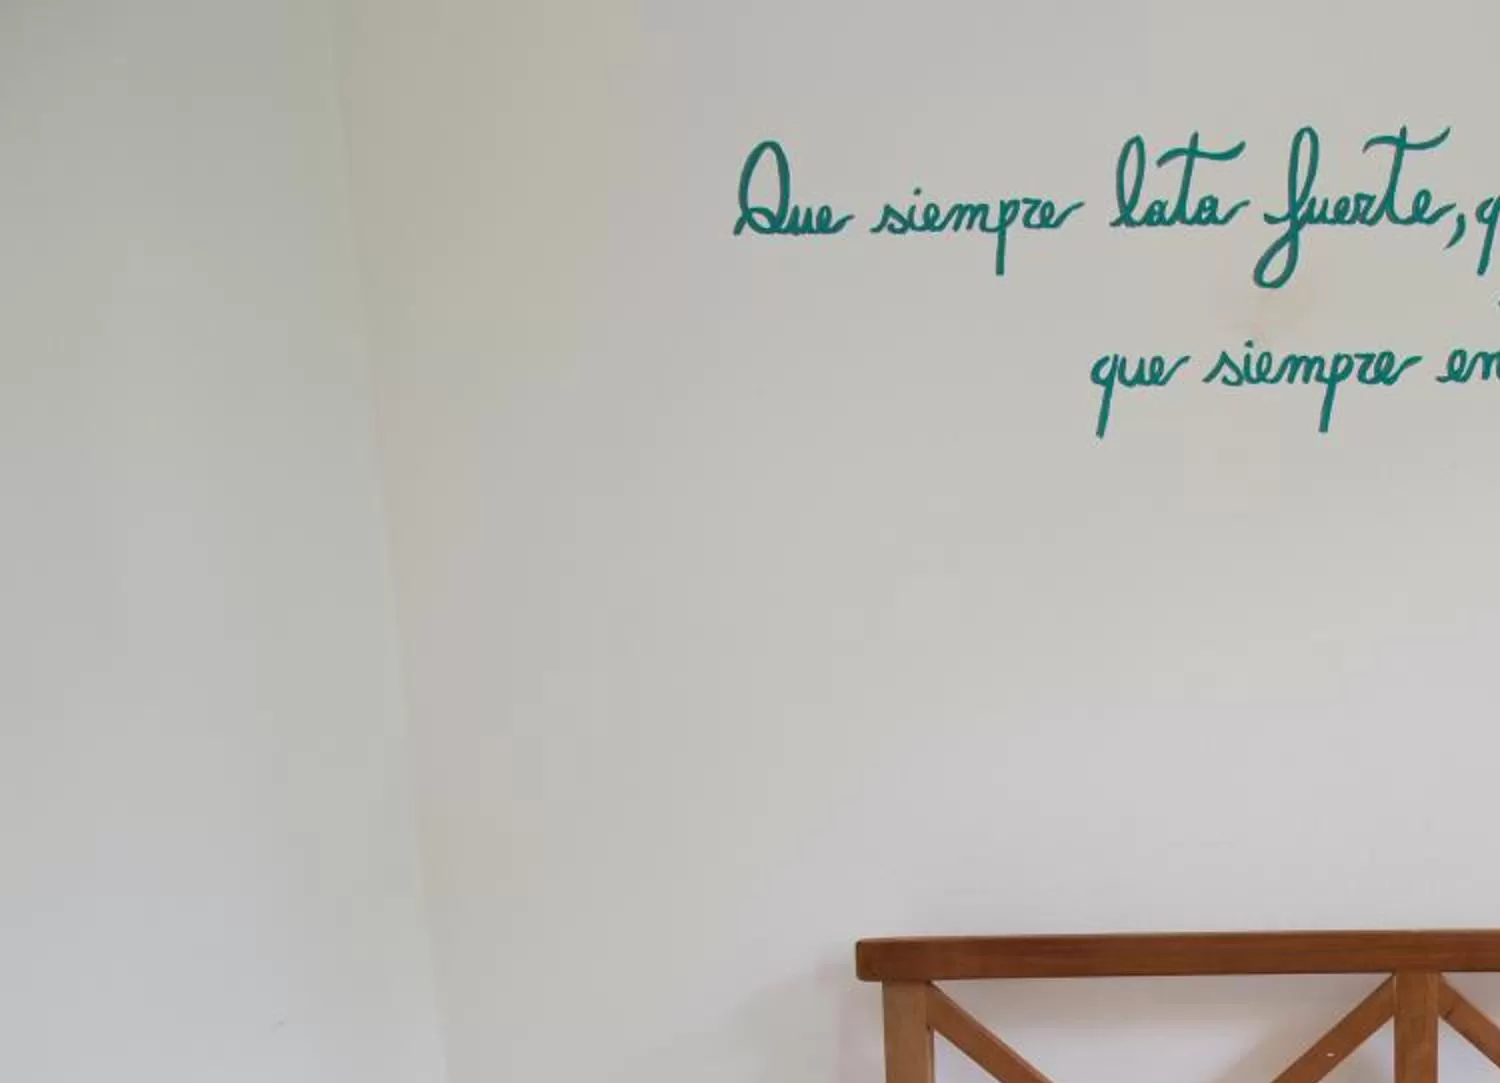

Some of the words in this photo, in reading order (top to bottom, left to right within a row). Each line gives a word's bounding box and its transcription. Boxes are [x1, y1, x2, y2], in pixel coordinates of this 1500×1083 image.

[735, 140, 854, 236] Que
[871, 187, 1084, 276] siempre
[1109, 131, 1251, 228] lata
[1253, 125, 1467, 289] fuerte,
[1090, 354, 1191, 438] que
[1202, 340, 1424, 434] siempre
